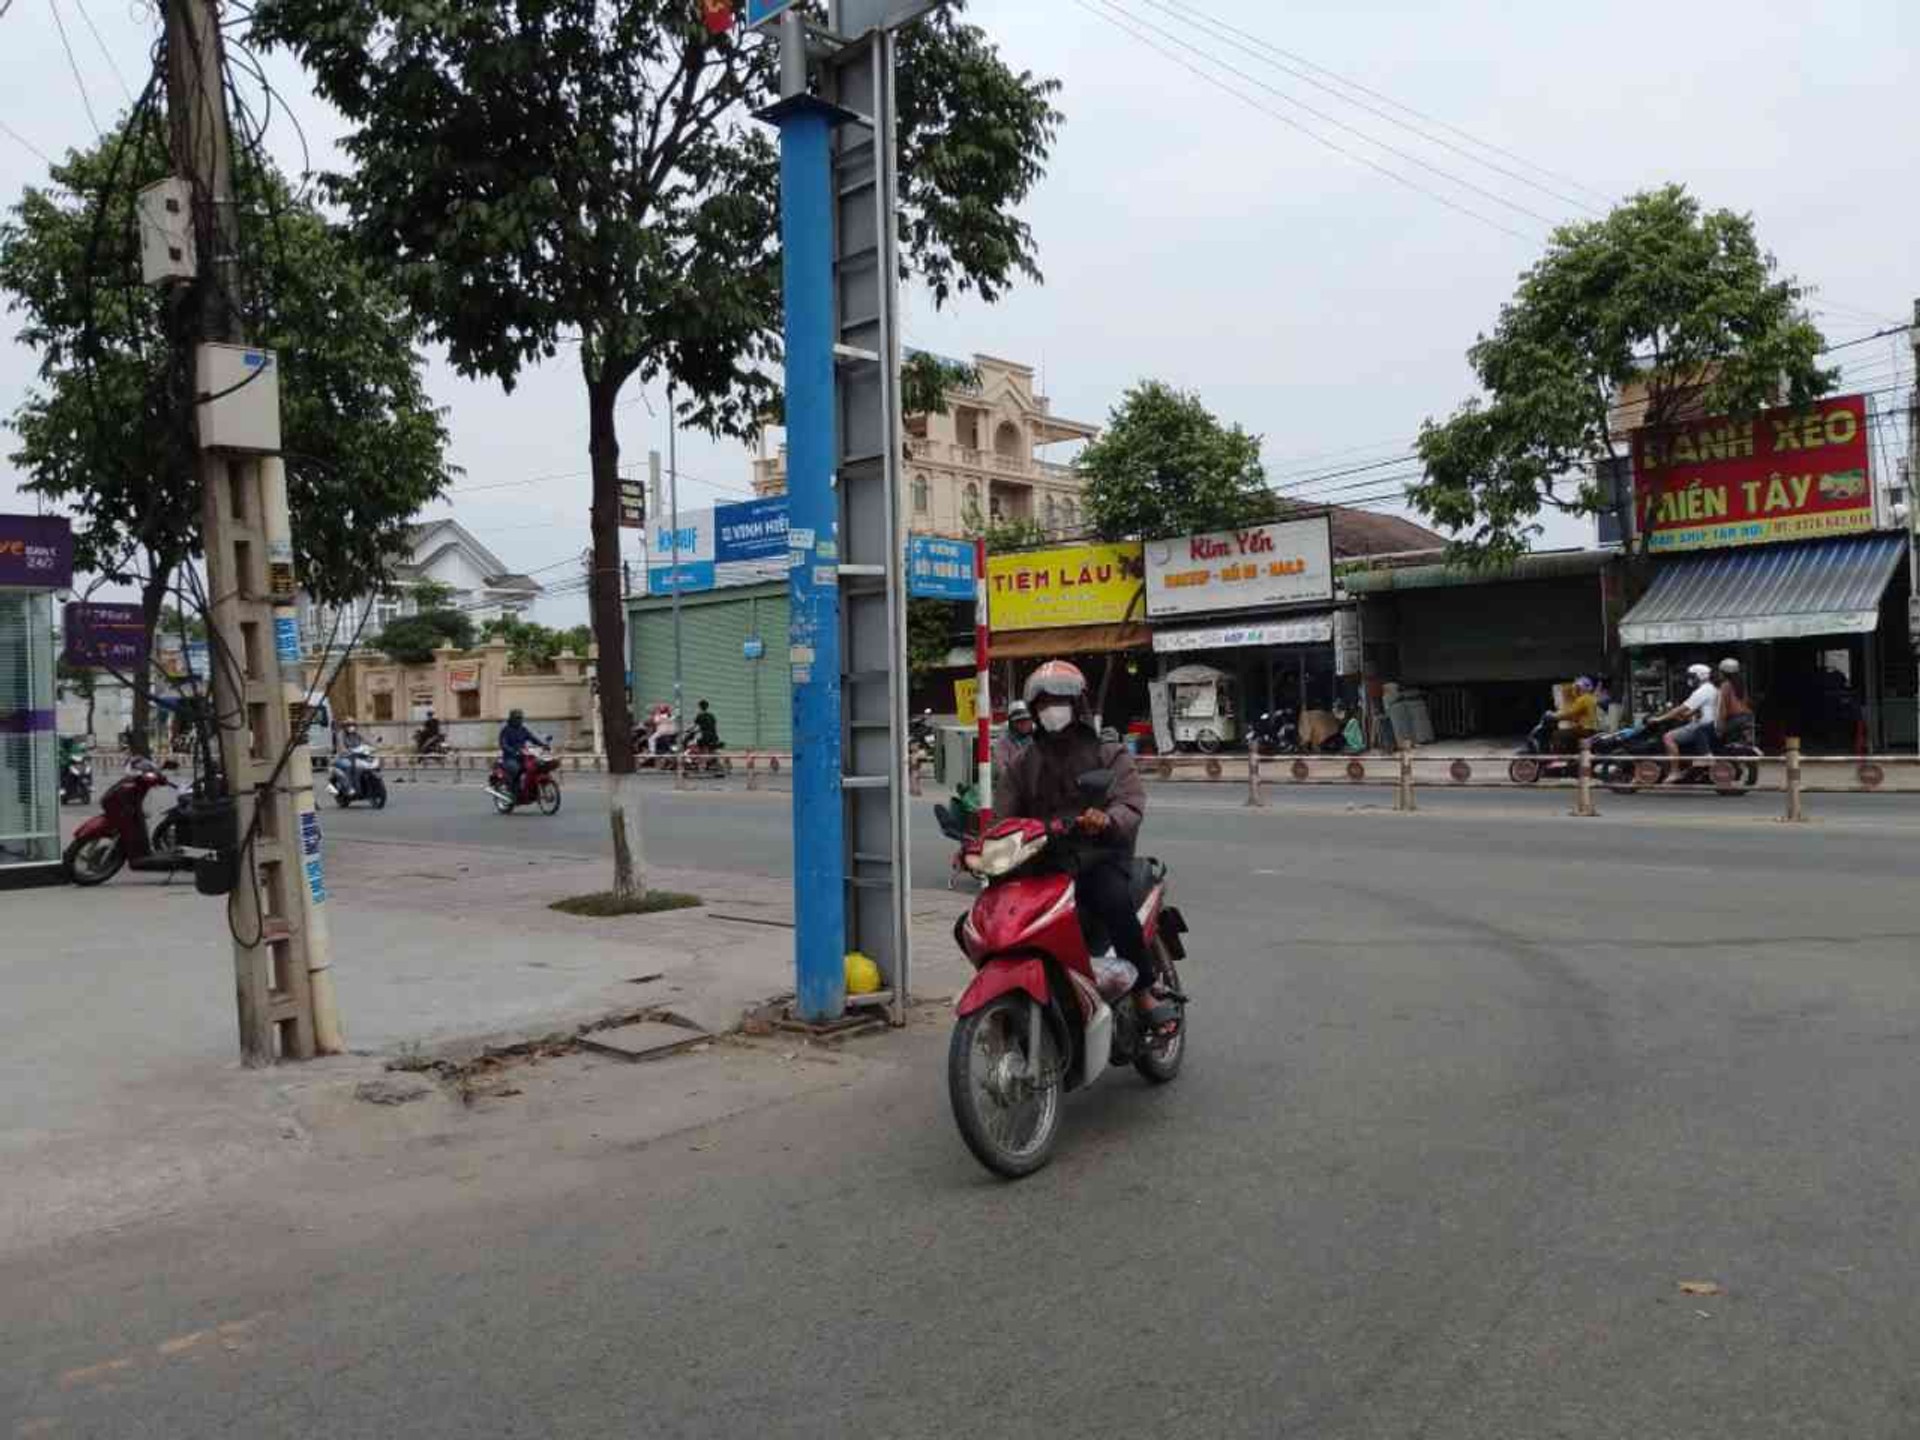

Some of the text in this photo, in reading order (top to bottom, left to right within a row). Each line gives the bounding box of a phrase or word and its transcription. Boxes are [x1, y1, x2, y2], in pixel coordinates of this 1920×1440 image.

[1644, 418, 1753, 469] ÁNH
[1741, 471, 1812, 514] TÂY
[1190, 537, 1229, 560] Kim
